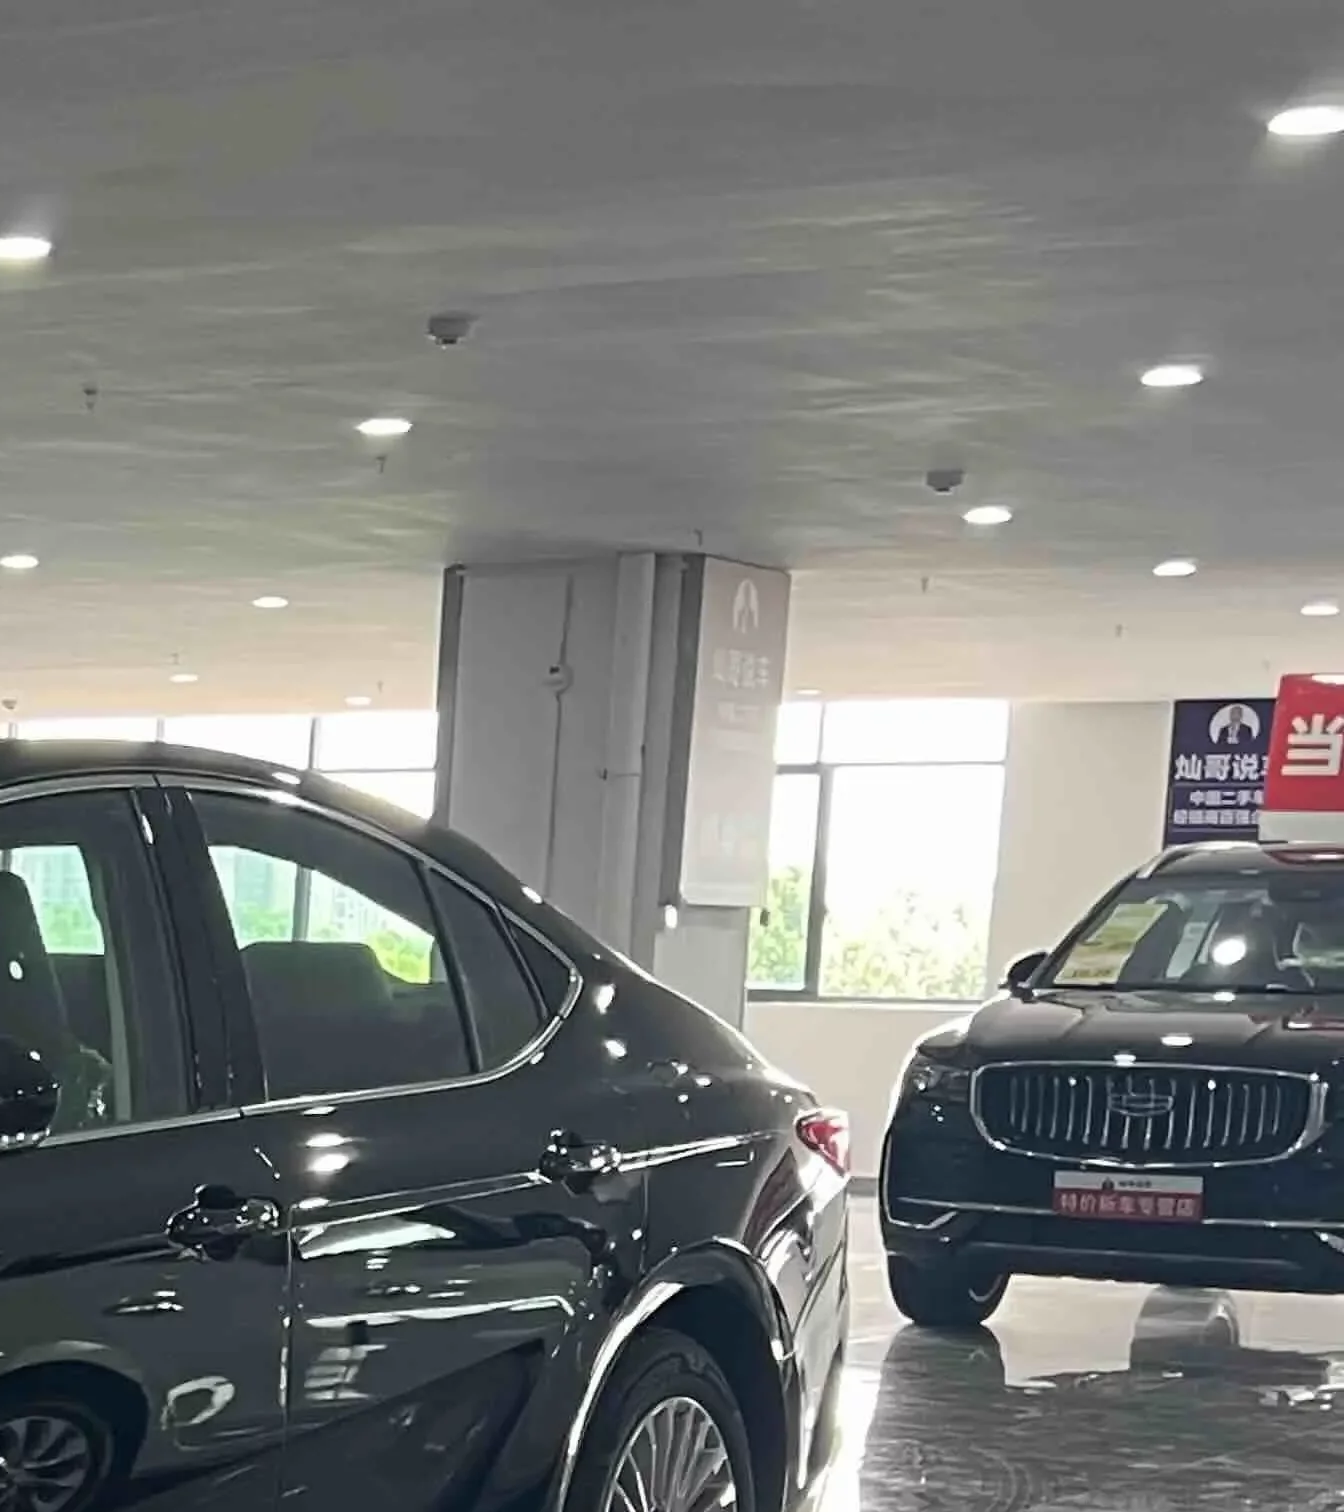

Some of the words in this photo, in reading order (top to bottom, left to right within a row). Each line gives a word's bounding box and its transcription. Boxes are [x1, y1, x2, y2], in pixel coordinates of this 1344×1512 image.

[1174, 753, 1269, 781] 灿哥说
[1281, 713, 1344, 776] 当
